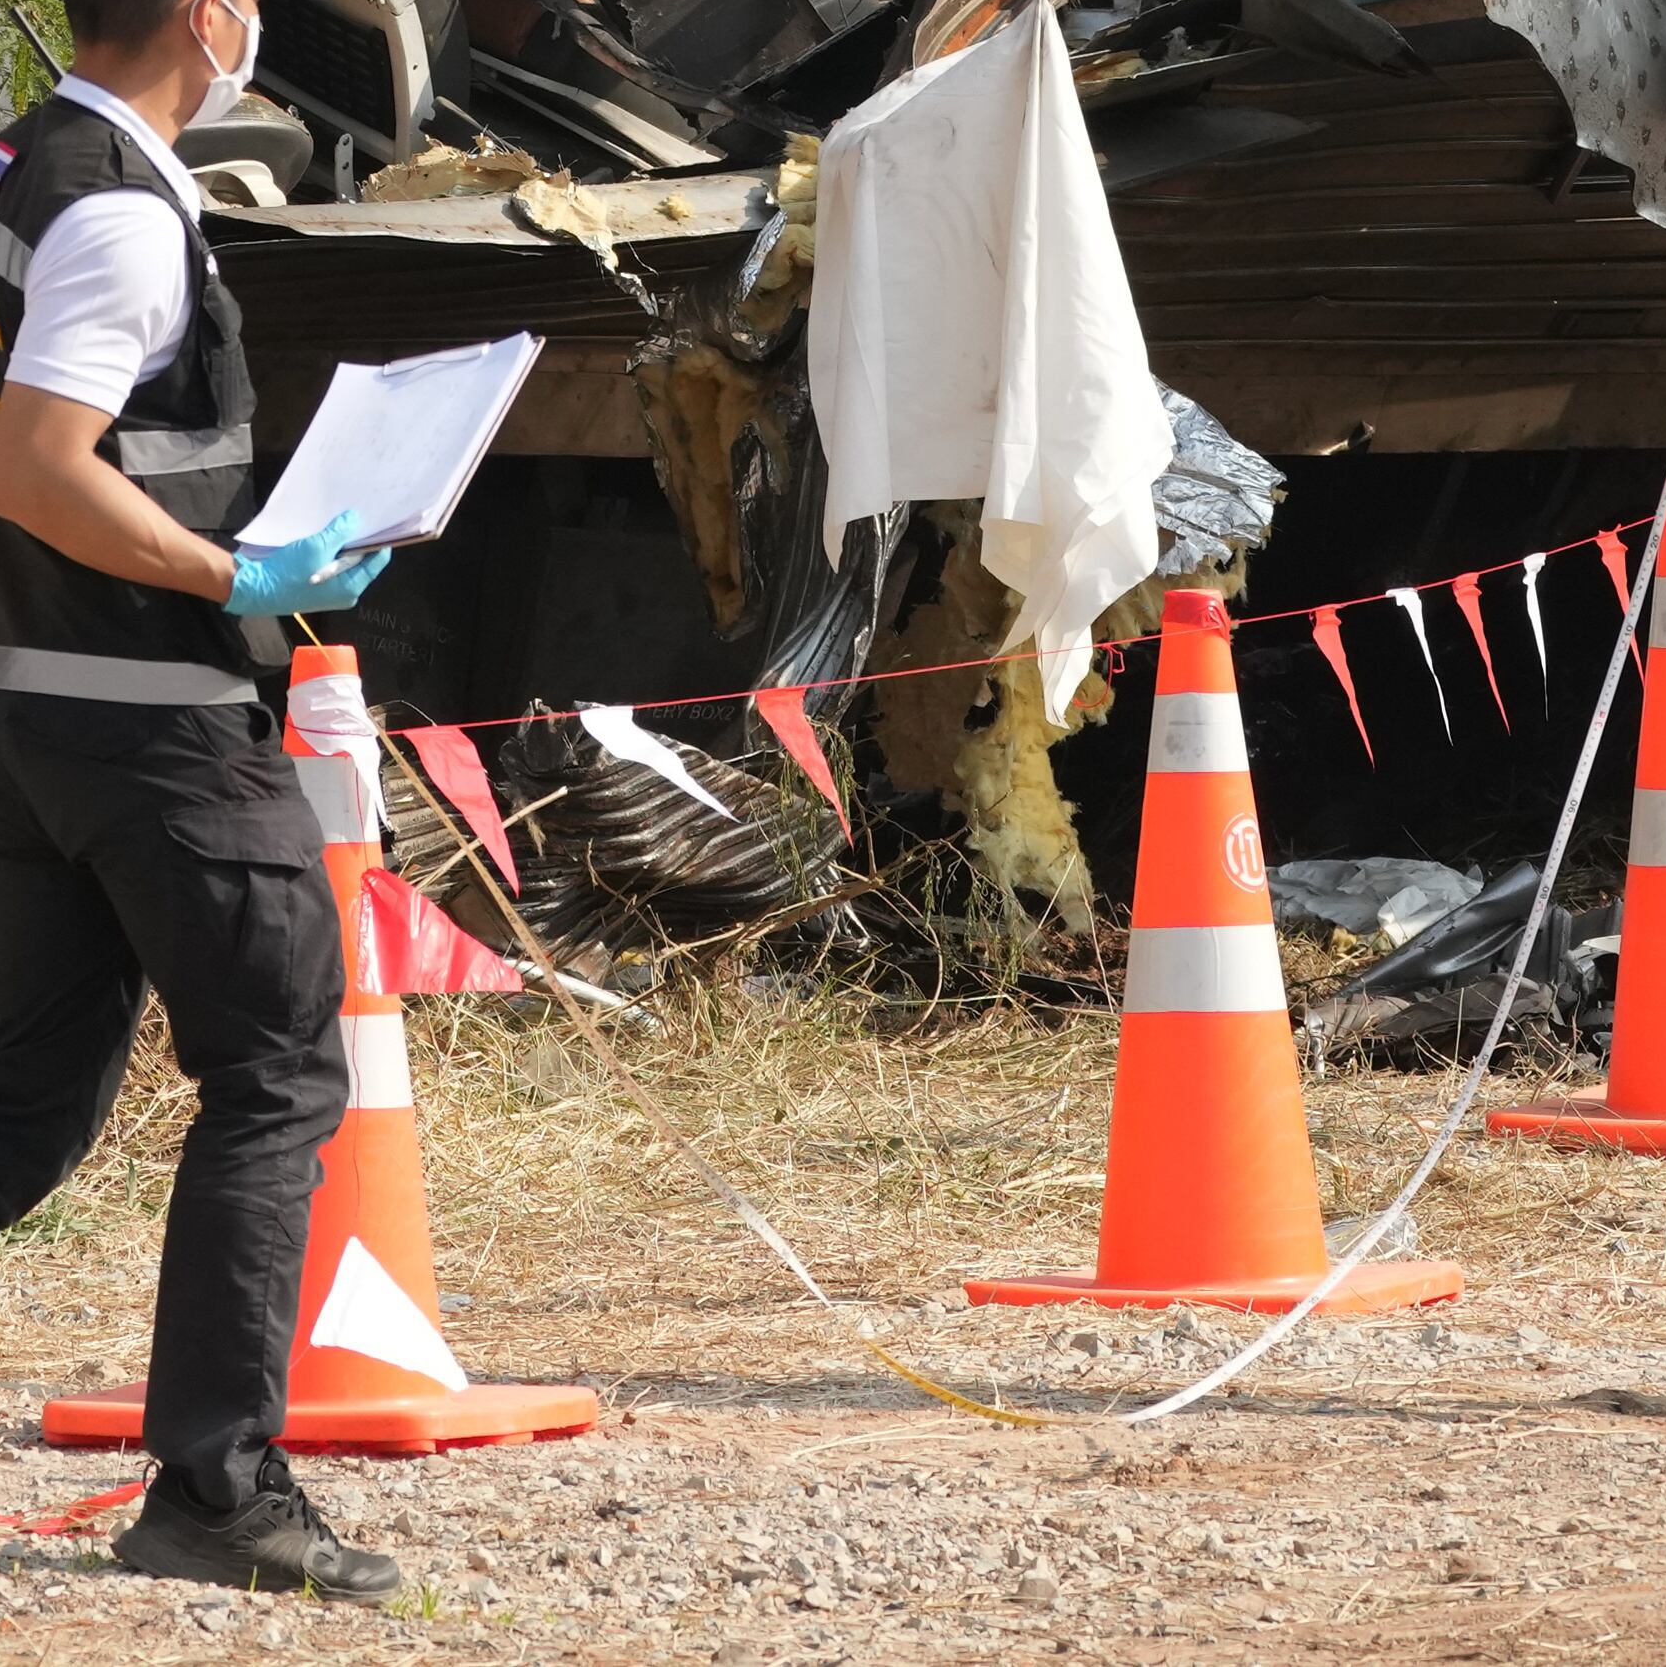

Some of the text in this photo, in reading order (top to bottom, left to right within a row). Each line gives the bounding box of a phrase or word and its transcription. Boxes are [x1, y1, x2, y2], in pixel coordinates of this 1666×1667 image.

[1650, 534, 1660, 549] 20
[357, 605, 397, 631] MAIN
[1624, 624, 1633, 638] 10
[1567, 799, 1579, 814] 90
[1540, 885, 1550, 900] 80
[1512, 971, 1521, 985] 70
